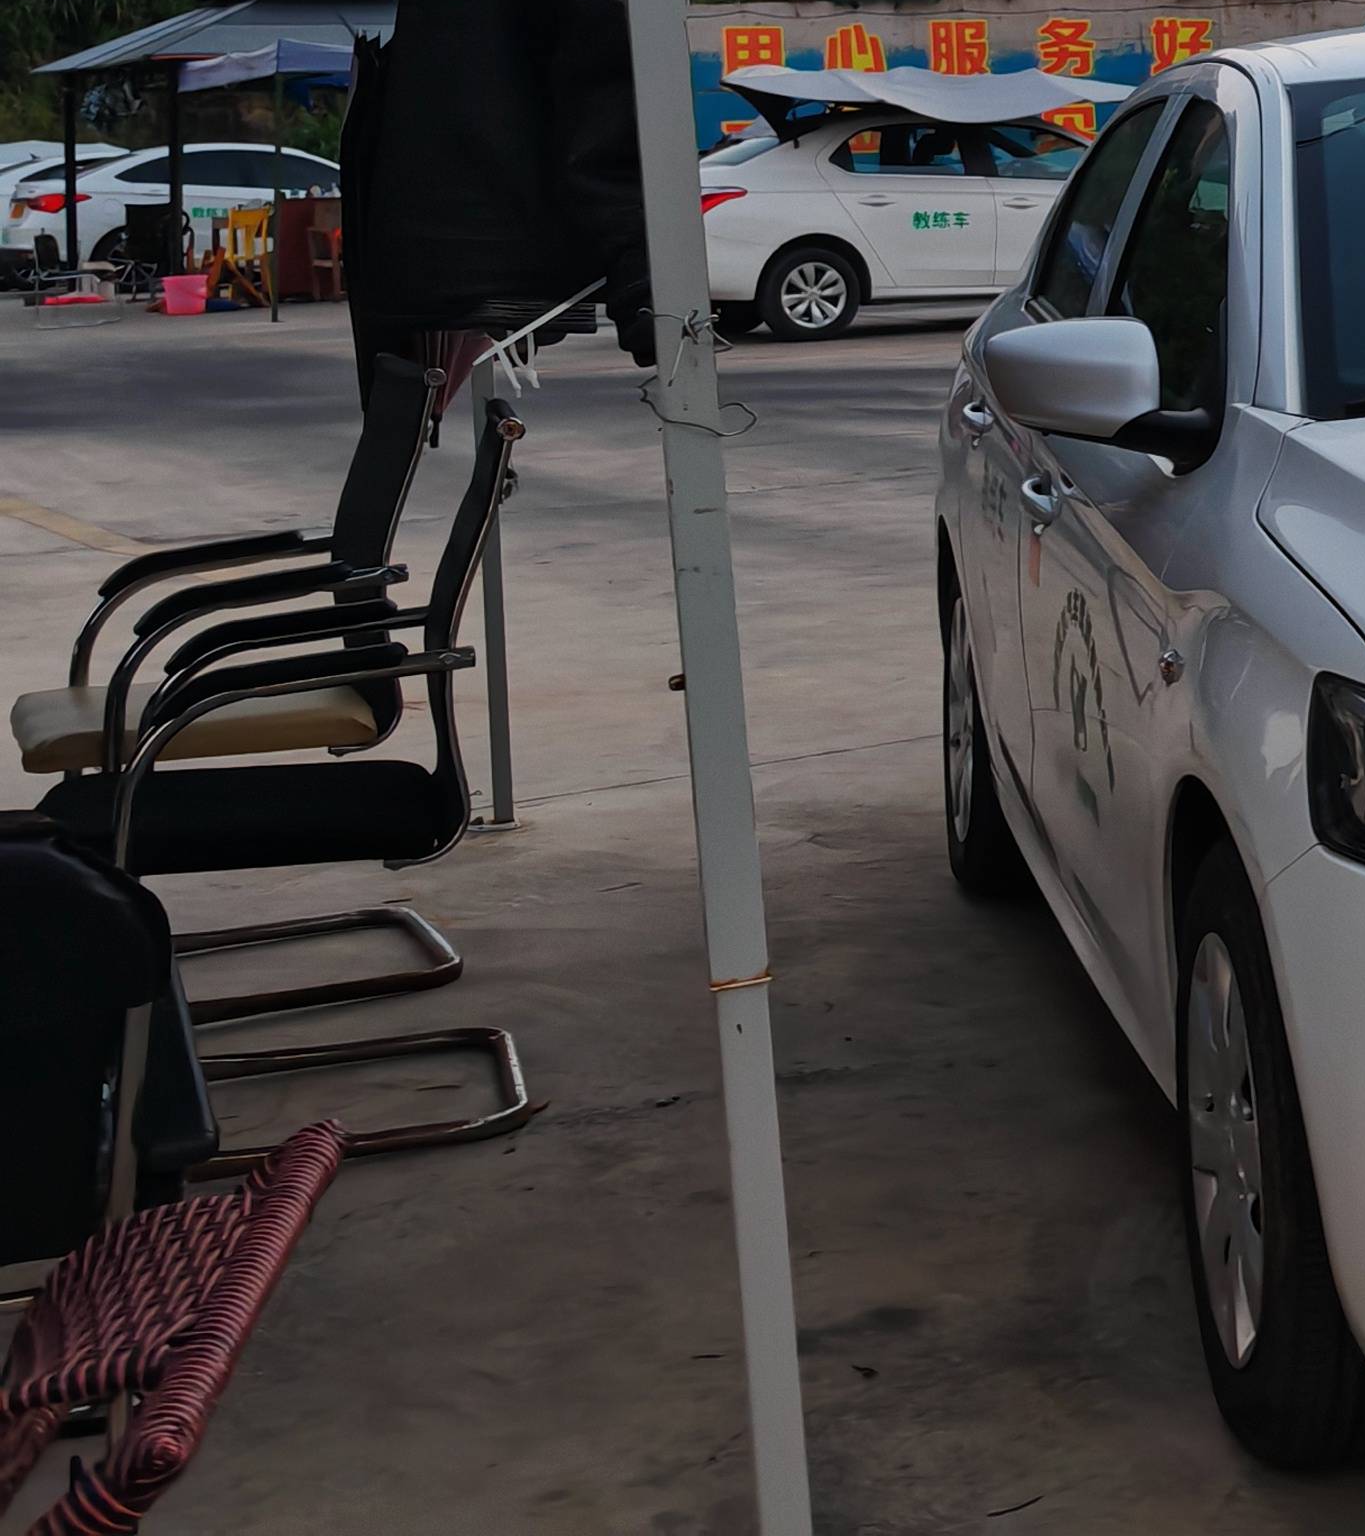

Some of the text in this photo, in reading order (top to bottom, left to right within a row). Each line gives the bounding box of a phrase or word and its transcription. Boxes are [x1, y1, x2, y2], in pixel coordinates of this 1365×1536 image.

[722, 17, 1213, 77] 用心服务好
[912, 211, 971, 229] 教练车
